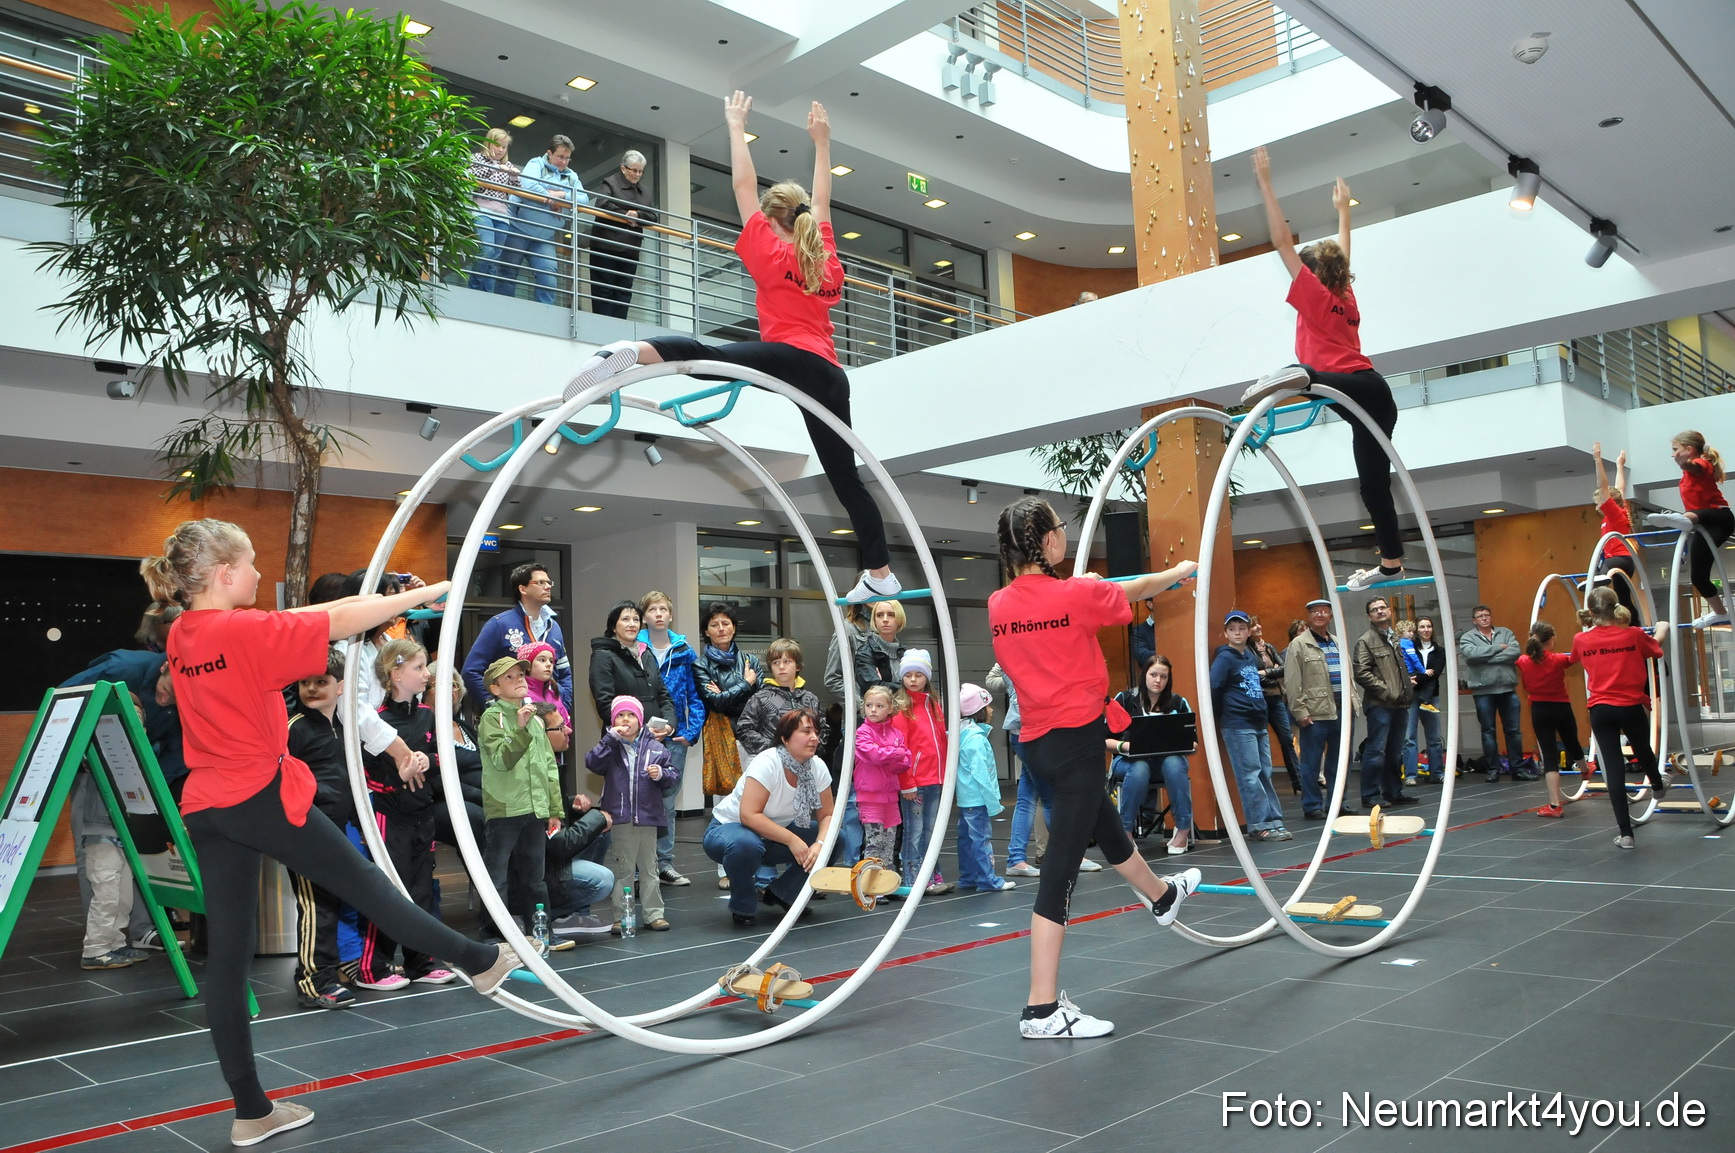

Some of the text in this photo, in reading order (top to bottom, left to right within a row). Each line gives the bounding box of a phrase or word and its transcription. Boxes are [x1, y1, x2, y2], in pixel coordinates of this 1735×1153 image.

[991, 613, 1070, 637] SV Rhönrad
[1583, 649, 1597, 658] ASV
